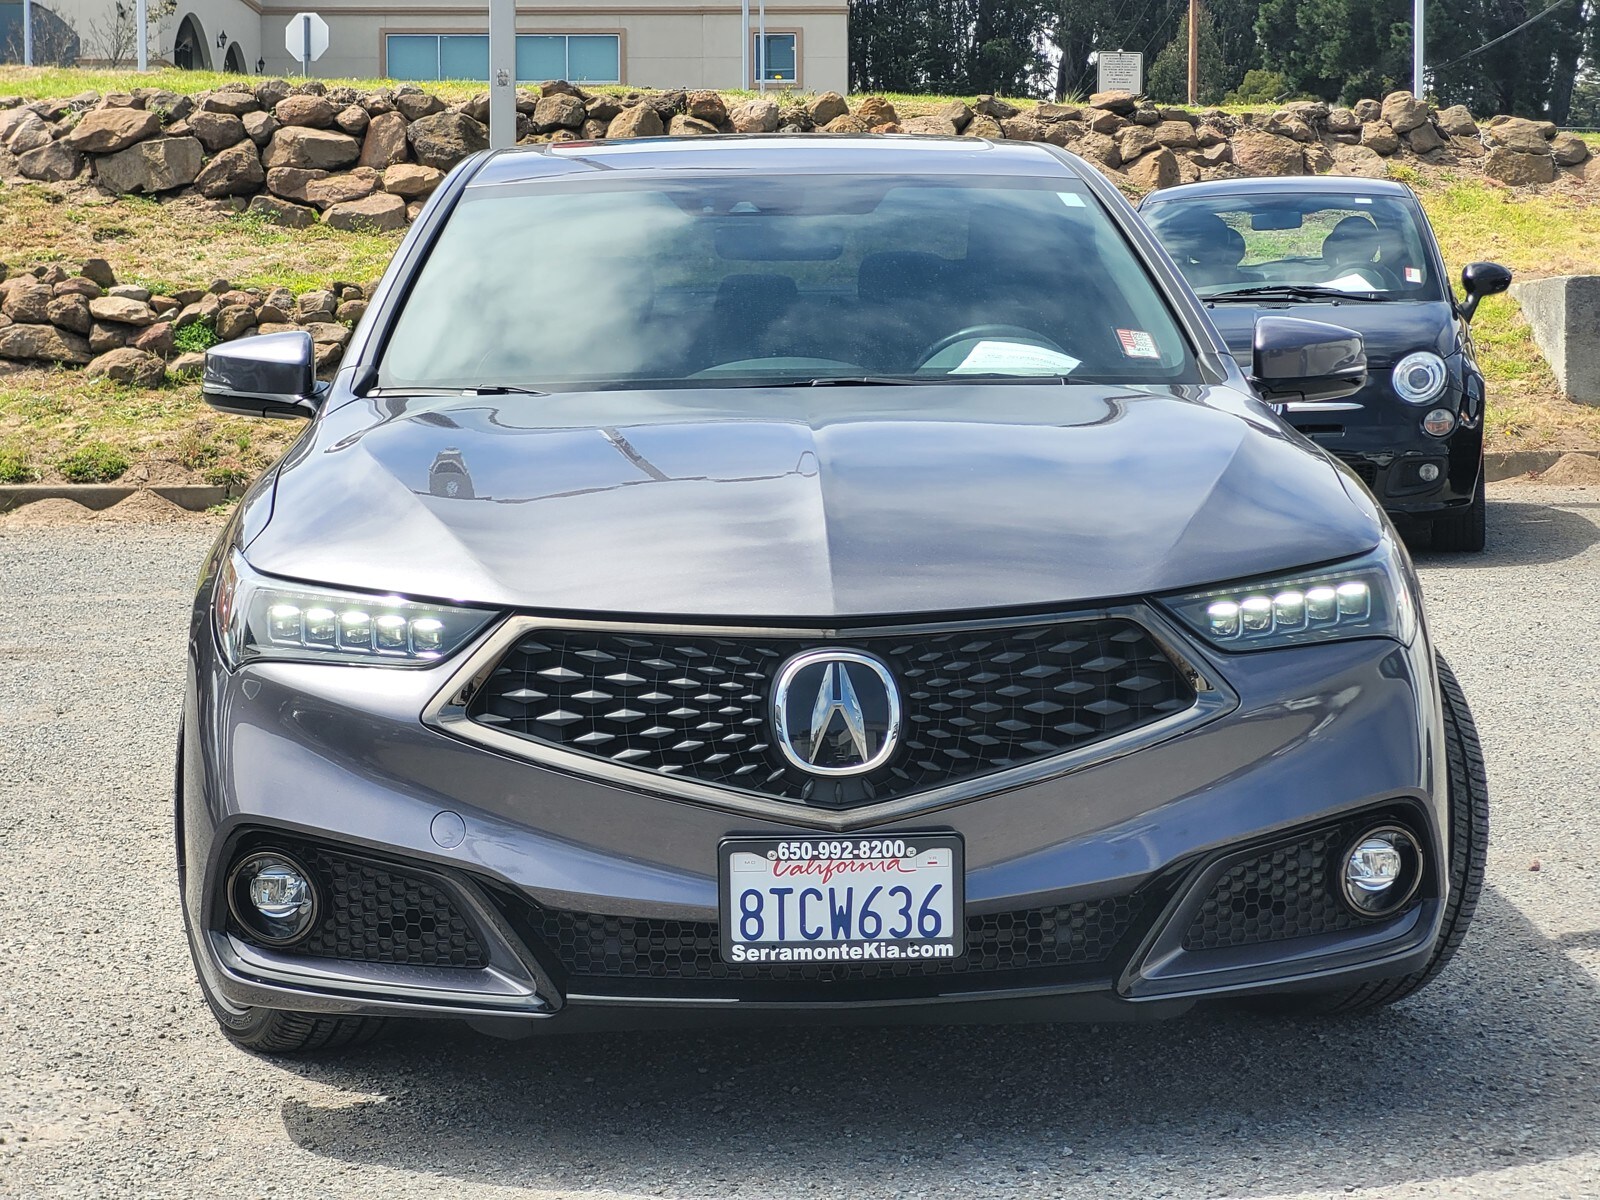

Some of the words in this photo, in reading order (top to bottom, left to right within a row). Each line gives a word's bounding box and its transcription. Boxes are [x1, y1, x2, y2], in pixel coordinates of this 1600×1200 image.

[777, 840, 905, 860] 650-992-8200
[772, 859, 917, 884] California
[740, 884, 942, 941] 8TCW636
[731, 942, 954, 962] SerramonteKia.com
